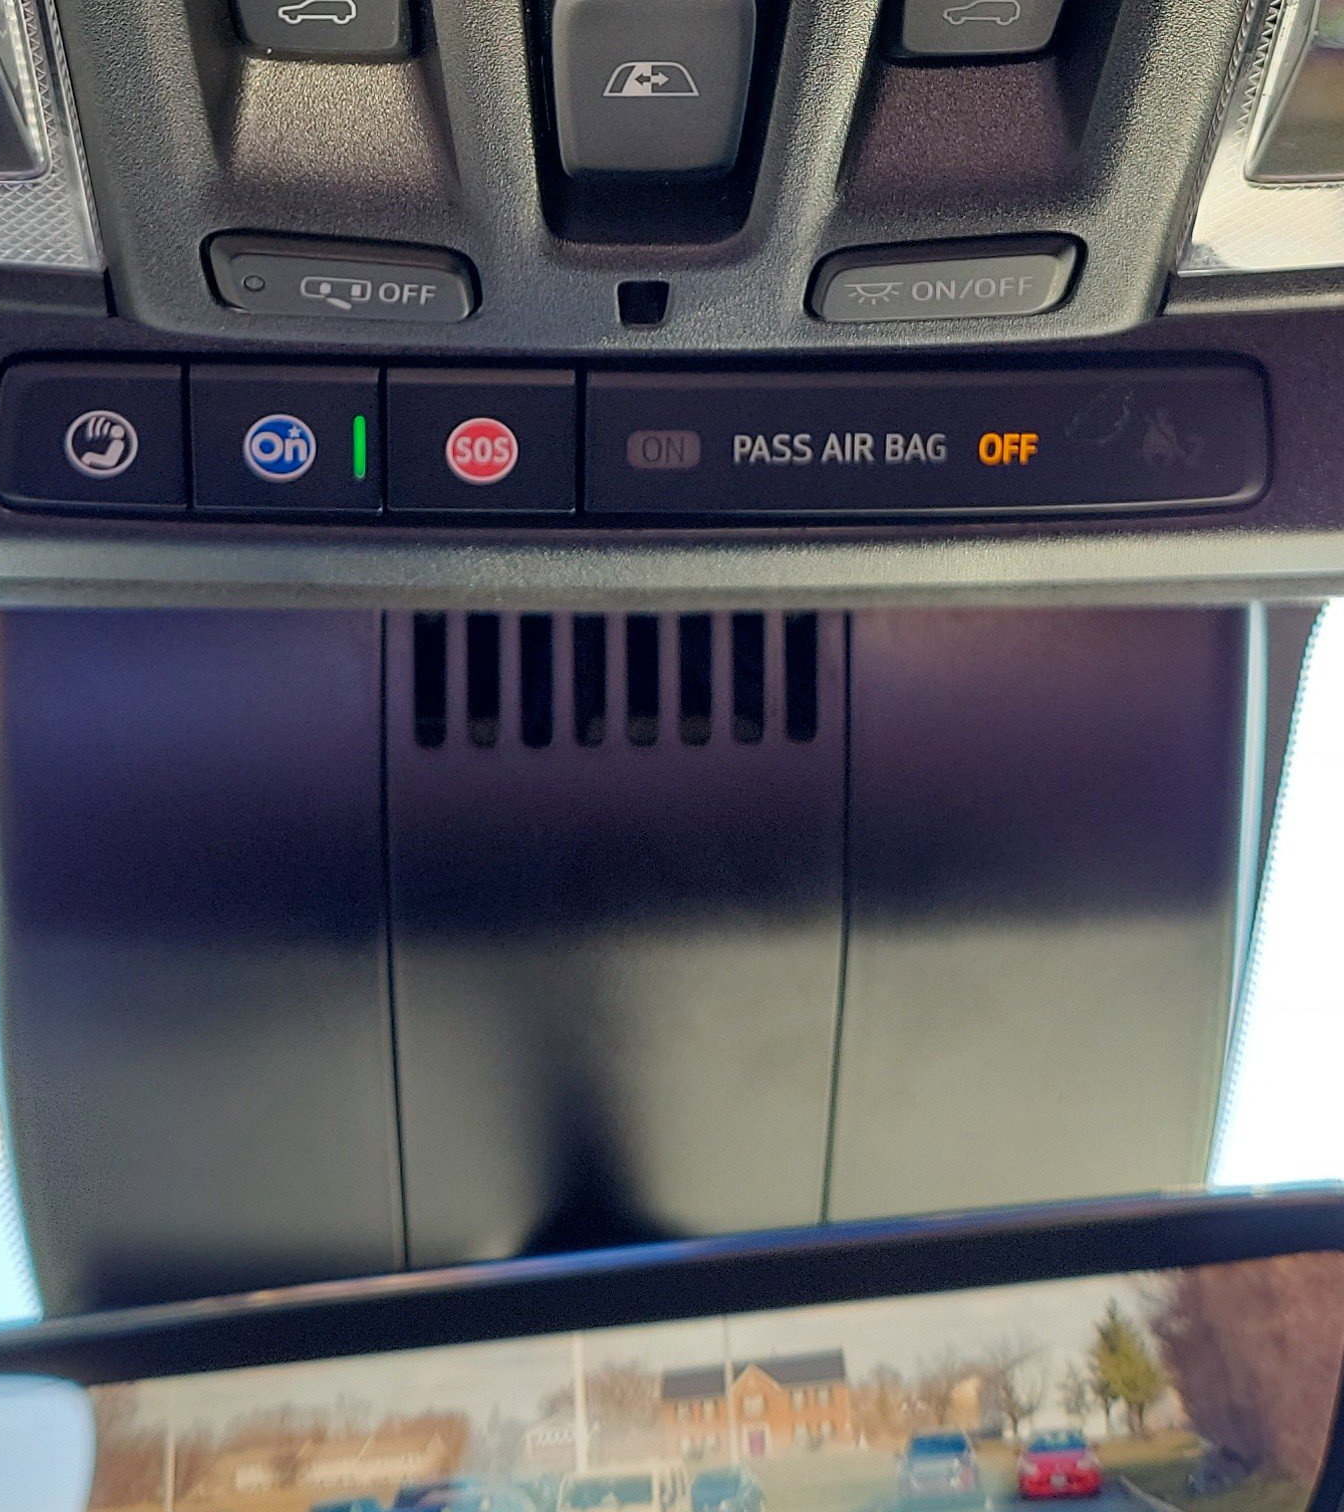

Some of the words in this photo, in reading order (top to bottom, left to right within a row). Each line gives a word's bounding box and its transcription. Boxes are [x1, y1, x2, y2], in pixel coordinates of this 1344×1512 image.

[378, 282, 437, 306] OFF
[911, 276, 1034, 301] ON/OFF
[252, 429, 308, 463] On
[456, 434, 511, 464] SOS
[641, 436, 686, 463] ON
[732, 434, 813, 464] PASS
[820, 433, 874, 463] AIR
[885, 433, 948, 463] BAG
[978, 432, 1040, 466] OFF
